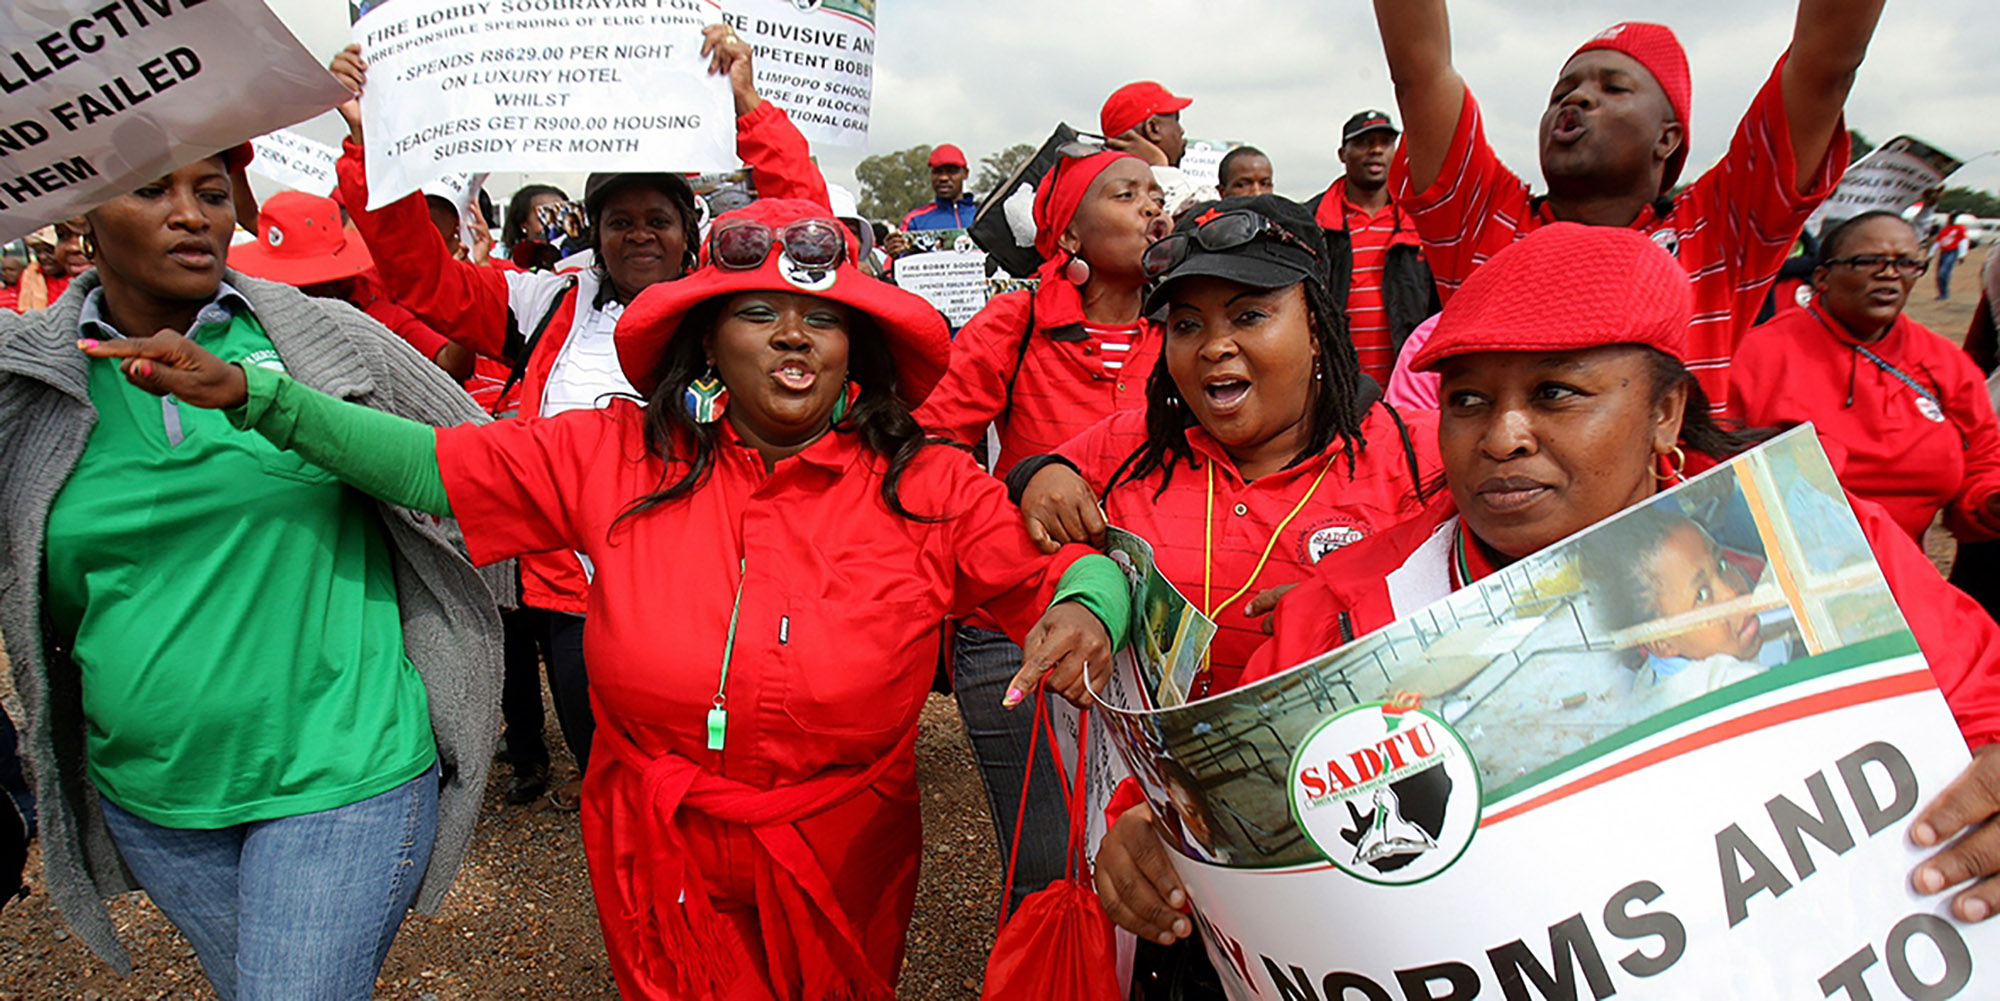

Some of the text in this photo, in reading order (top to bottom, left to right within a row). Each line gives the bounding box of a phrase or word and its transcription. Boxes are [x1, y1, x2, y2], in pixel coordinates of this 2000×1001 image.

[367, 21, 410, 48] FIRE
[416, 2, 491, 29] BOBBY
[367, 26, 479, 66] IRRESPONSIBLE
[484, 14, 570, 32] SPENDING
[575, 16, 596, 27] OF
[756, 20, 848, 50] DIVISIVE
[0, 0, 208, 94] LLECTIV
[405, 44, 674, 82] SPENDS R8629.00 PER NIGHT
[50, 46, 202, 132] FAILED
[441, 68, 622, 91] ON LUXURY HOTEL
[758, 71, 821, 90] LIMPOPO
[494, 92, 571, 107] WHILST
[786, 108, 839, 126] TIONAL
[794, 93, 814, 105] BY
[394, 115, 701, 156] TEACHERS GET R900.00 HOUSING
[433, 138, 640, 161] SUBSIDY PER MONTH
[0, 156, 98, 210] HEM
[292, 160, 328, 181] CAPE
[902, 264, 920, 272] FIRE
[922, 263, 950, 271] BOBBY
[1300, 721, 1436, 799] SADTU
[1714, 741, 1919, 929] AND
[1817, 913, 1973, 1001] TO
